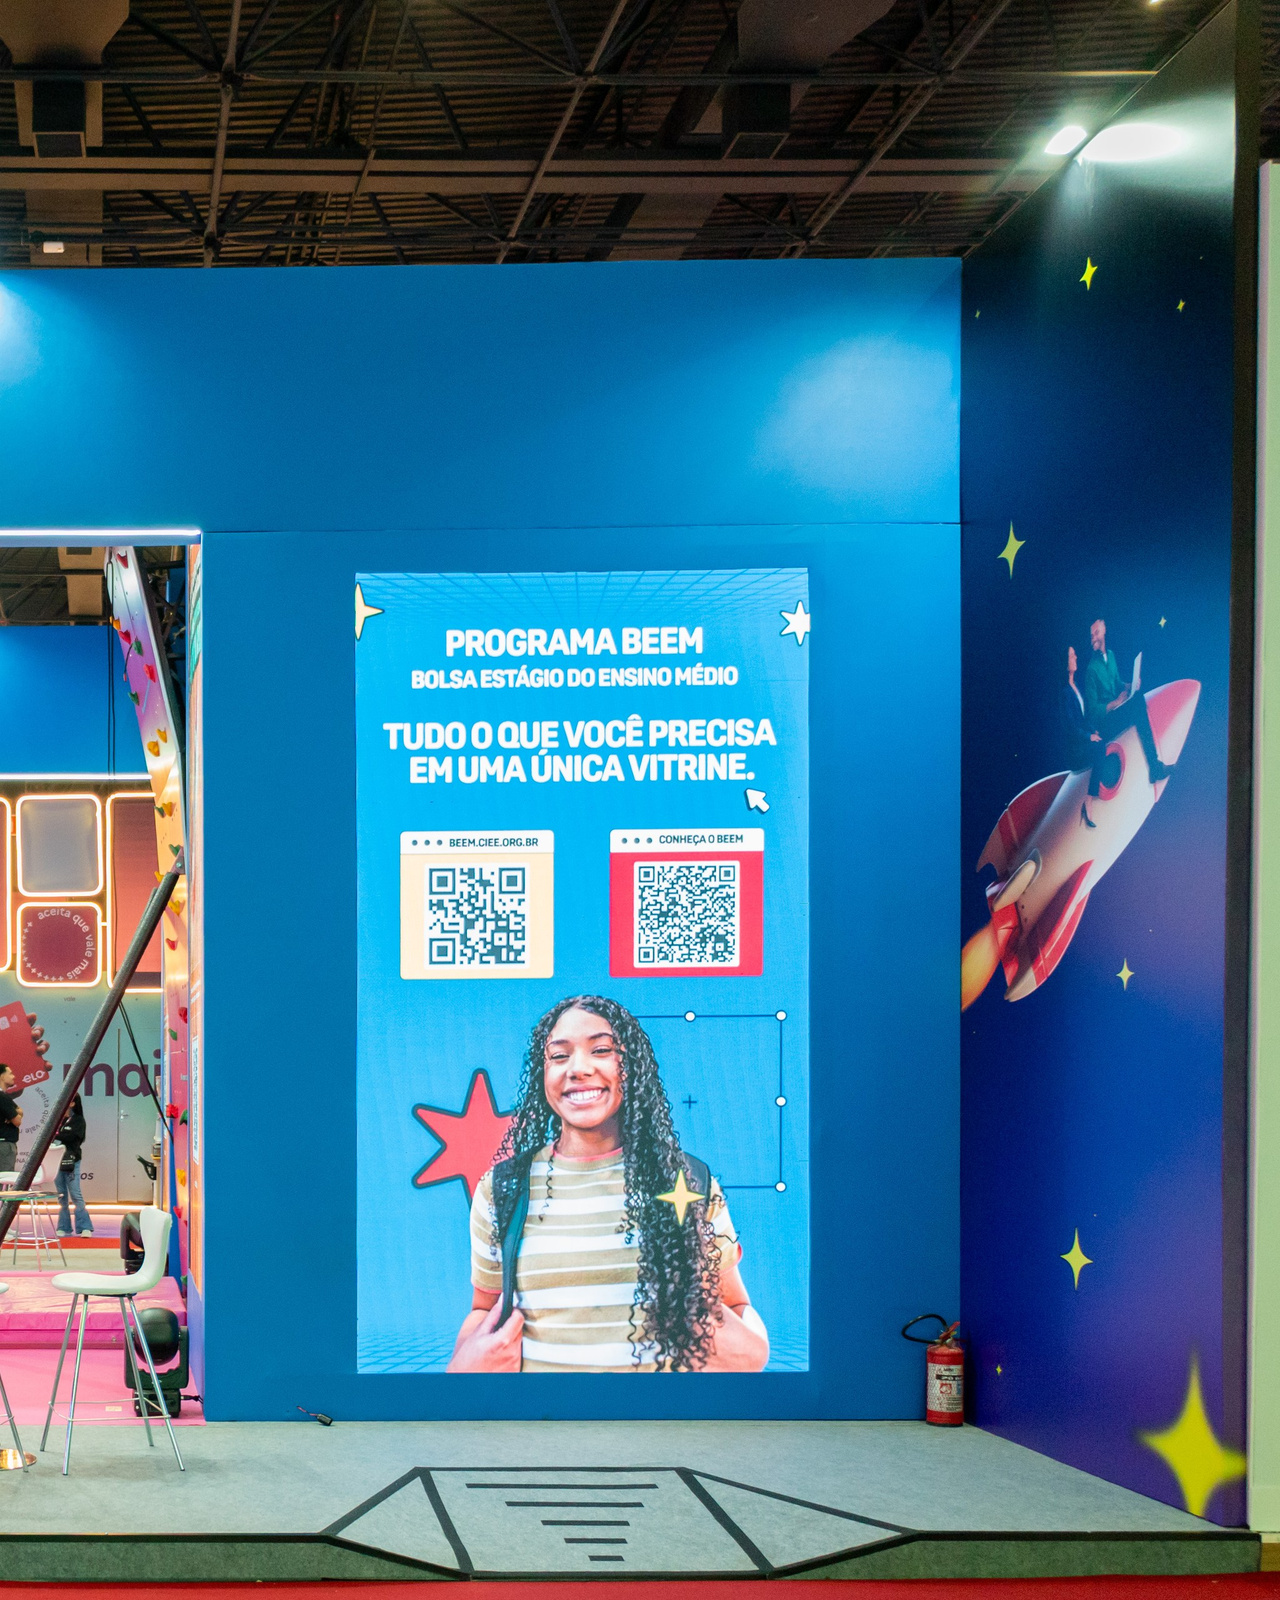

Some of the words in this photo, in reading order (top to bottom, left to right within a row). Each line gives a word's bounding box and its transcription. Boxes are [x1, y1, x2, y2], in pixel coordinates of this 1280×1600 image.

[445, 627, 618, 657] PROGRAMA
[621, 626, 704, 655] BEEM
[411, 668, 478, 689] BOLSA
[480, 664, 564, 688] ESTÁGIO
[567, 667, 596, 688] DO
[598, 666, 672, 687] ENSINO
[674, 662, 739, 686] MÉDIO
[382, 721, 467, 750] TUDO
[471, 721, 493, 750] O
[497, 720, 560, 750] QUE
[562, 713, 644, 748] VOCÊ
[648, 718, 777, 748] PRECISA
[409, 755, 453, 784] EM
[458, 754, 527, 784] UMA
[531, 748, 626, 784] ÚNICA
[628, 753, 756, 782] VITRINE.
[449, 837, 539, 848] BEEM.CIEE.ORG.BR
[658, 834, 707, 846] CONHEÇA
[708, 834, 715, 844] O
[717, 834, 744, 844] BEEM
[37, 908, 71, 920] aceita
[72, 914, 89, 933] que
[84, 934, 96, 958] vale
[66, 958, 89, 980] mais
